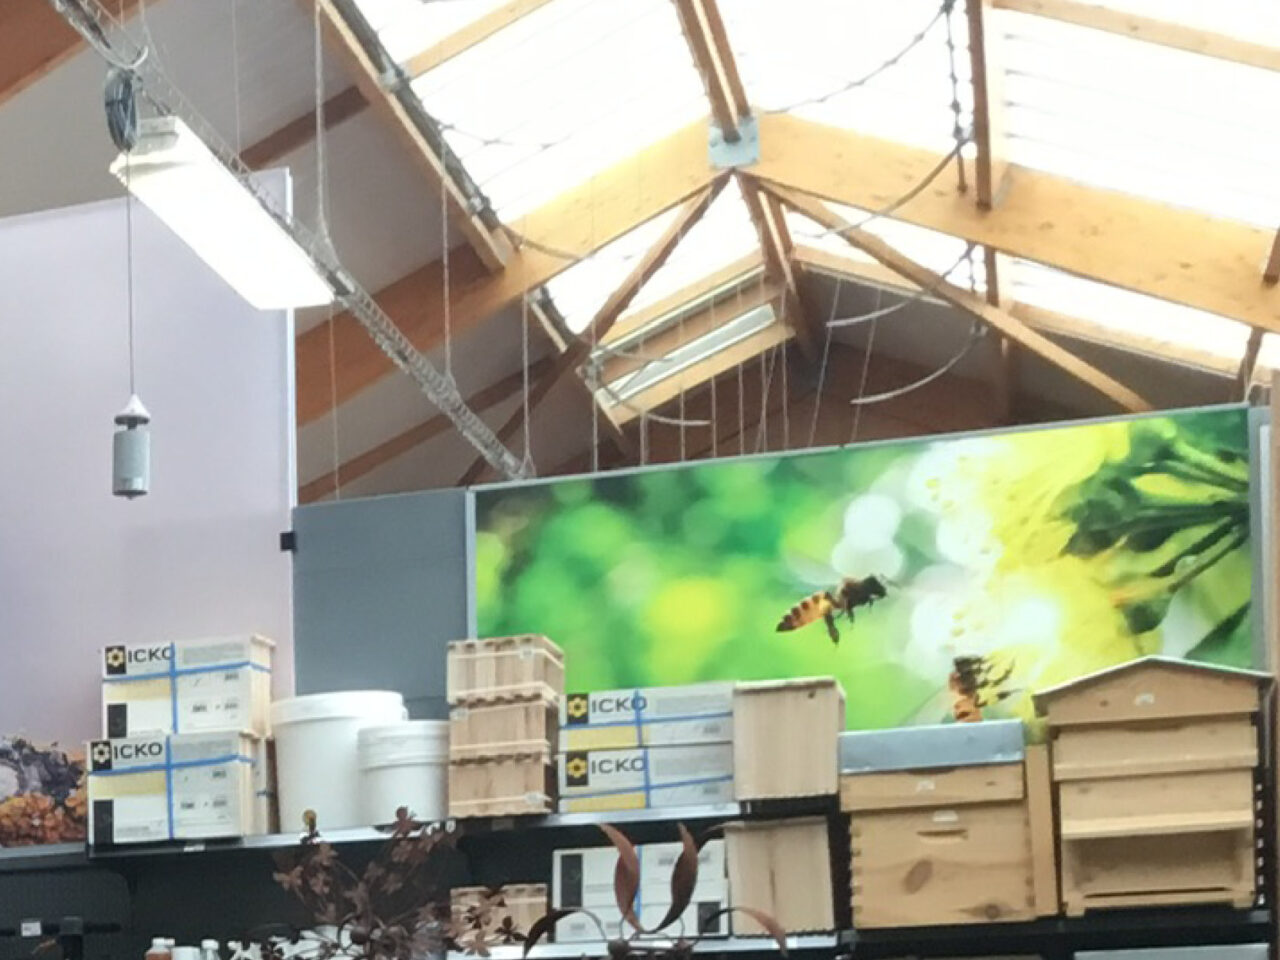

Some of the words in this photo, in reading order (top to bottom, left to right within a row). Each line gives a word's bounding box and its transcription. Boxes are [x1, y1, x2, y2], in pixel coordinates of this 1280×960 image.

[592, 696, 648, 714] ICKO
[113, 742, 163, 760] ICKO
[591, 757, 646, 775] ICKO
